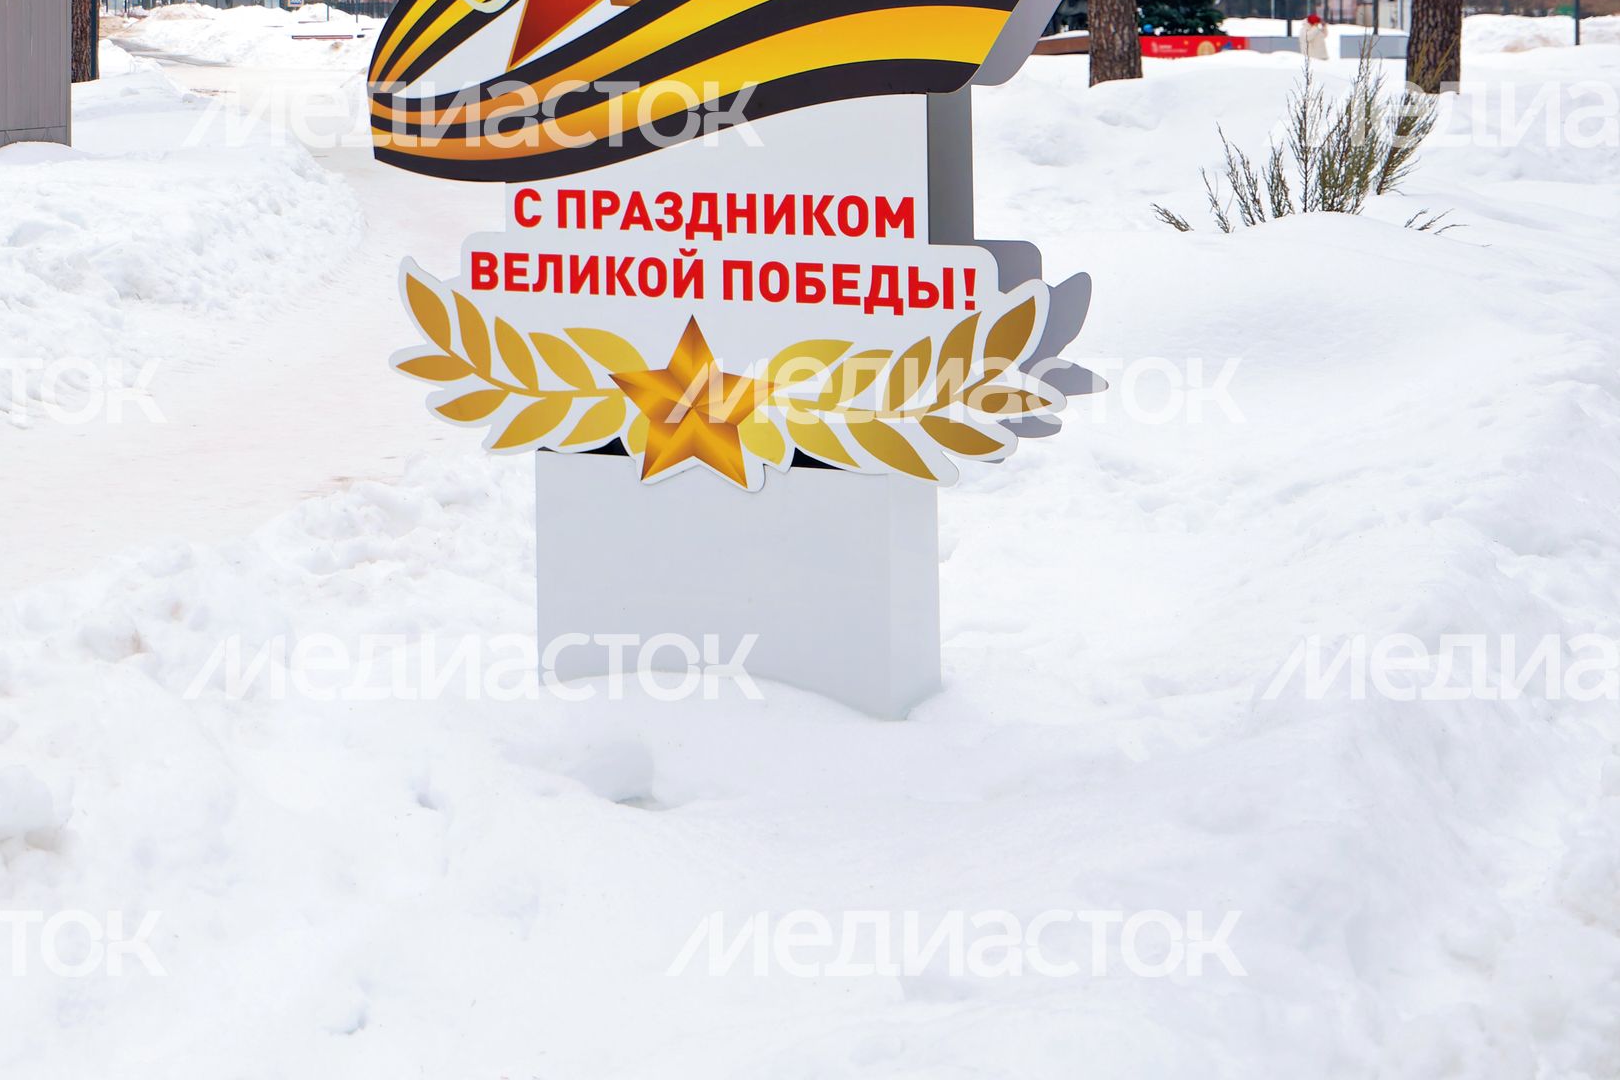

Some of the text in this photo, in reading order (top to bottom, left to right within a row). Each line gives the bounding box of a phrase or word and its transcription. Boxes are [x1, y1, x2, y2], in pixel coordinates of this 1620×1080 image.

[513, 188, 915, 242] С ПРАЗДНИКОМ
[470, 248, 977, 316] ВЕЛИКОЙ ПОБЕДЫ!
